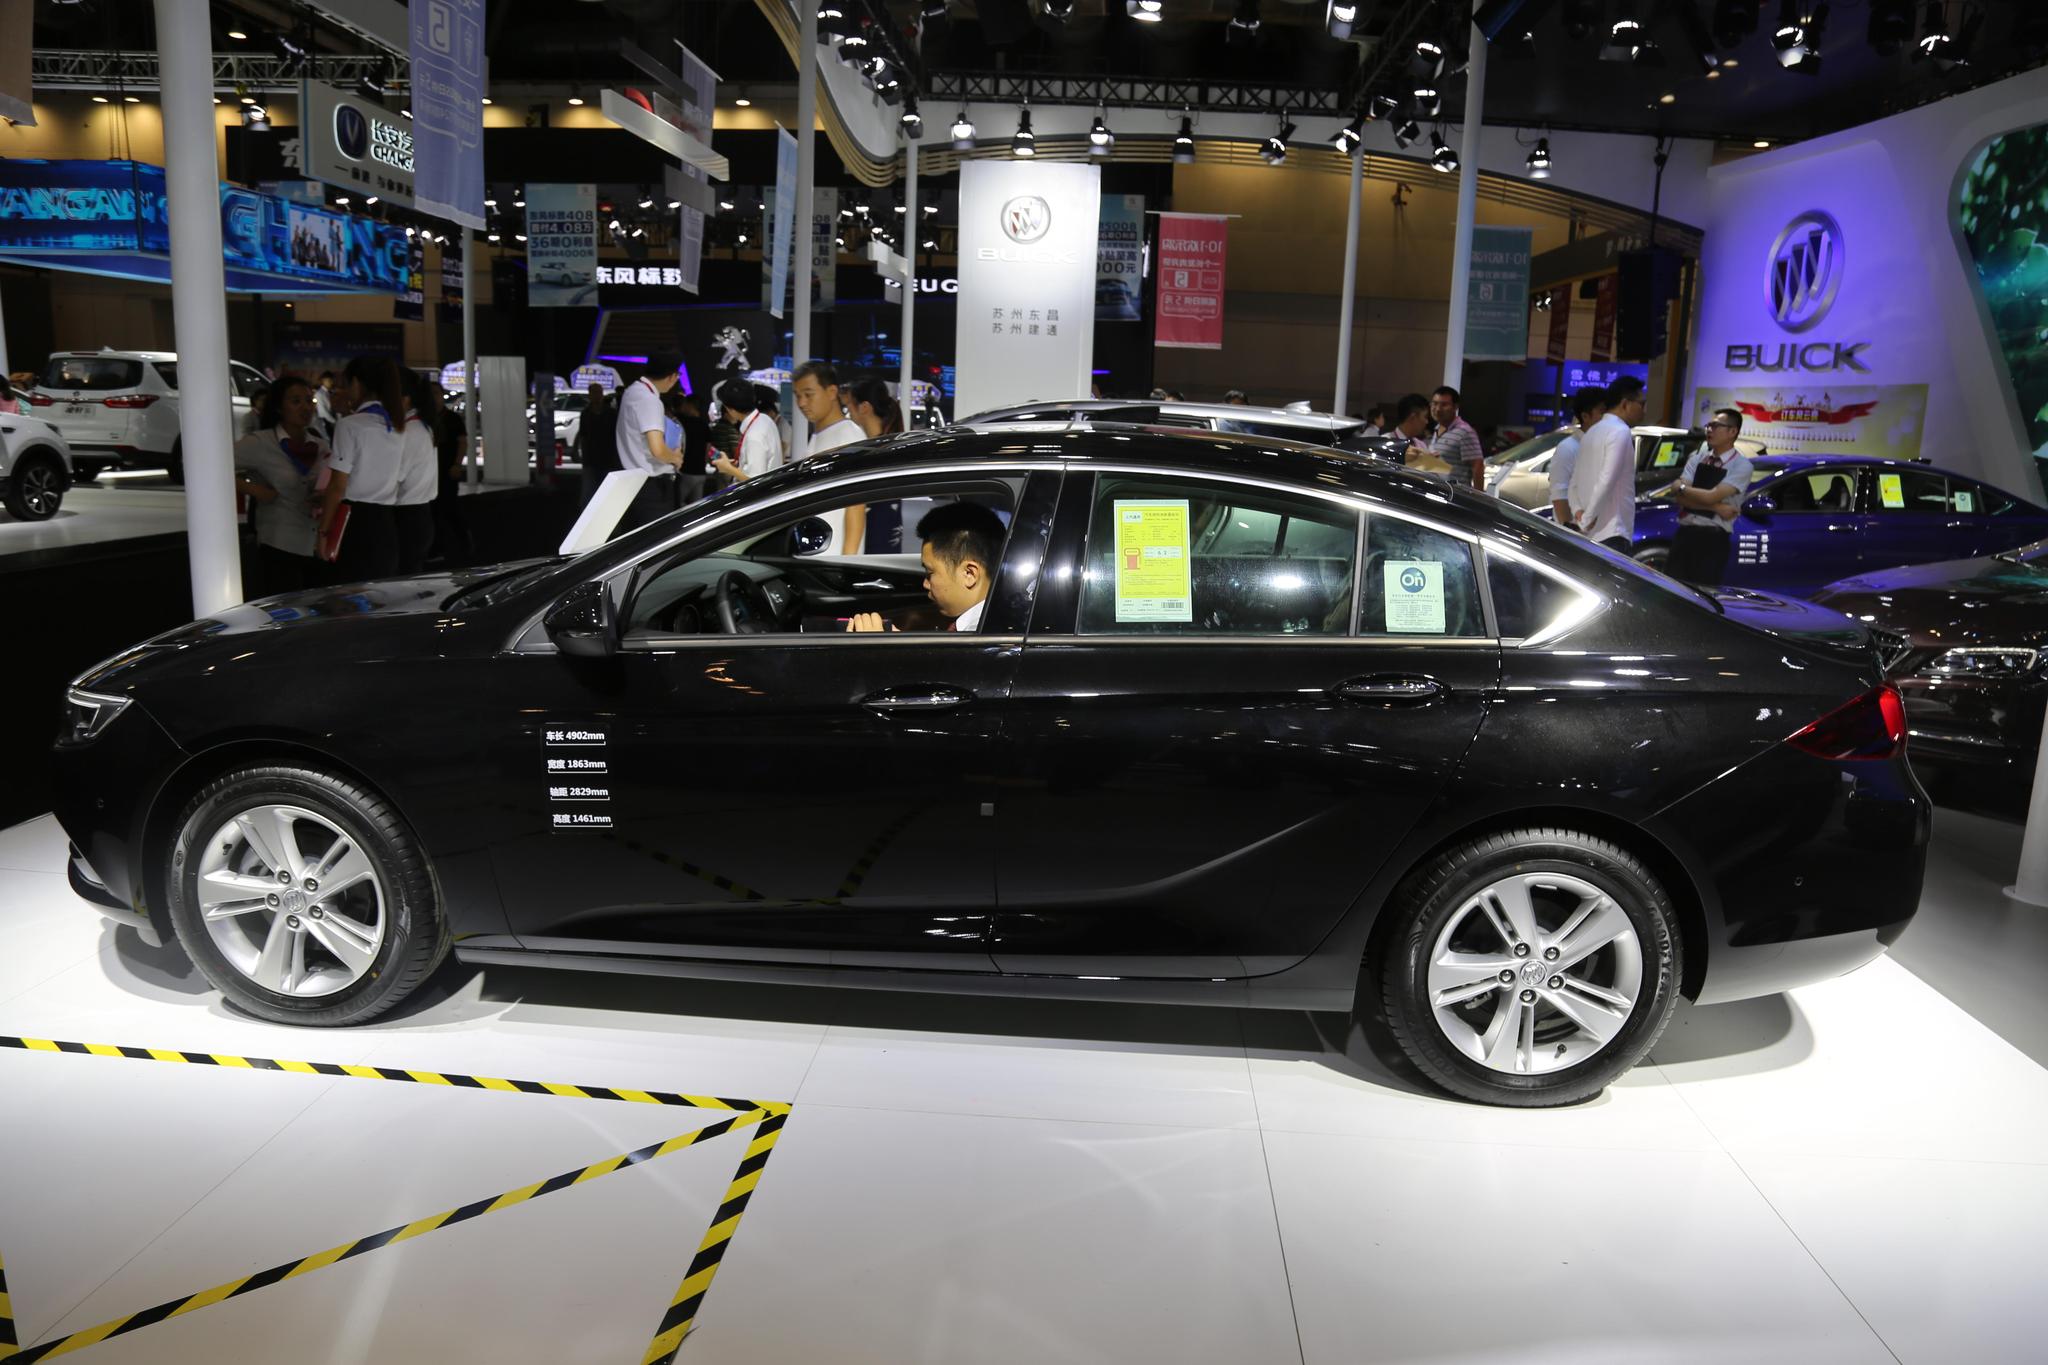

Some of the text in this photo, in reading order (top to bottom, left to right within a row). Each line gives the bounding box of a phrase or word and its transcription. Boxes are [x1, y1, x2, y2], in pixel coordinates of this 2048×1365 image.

[1725, 342, 1873, 374] BUICK
[1402, 572, 1425, 588] On
[546, 731, 605, 741] 车长 4902mm
[567, 760, 606, 769] 1863mm
[570, 787, 609, 796] 2829mm
[573, 814, 612, 823] 1461mm
